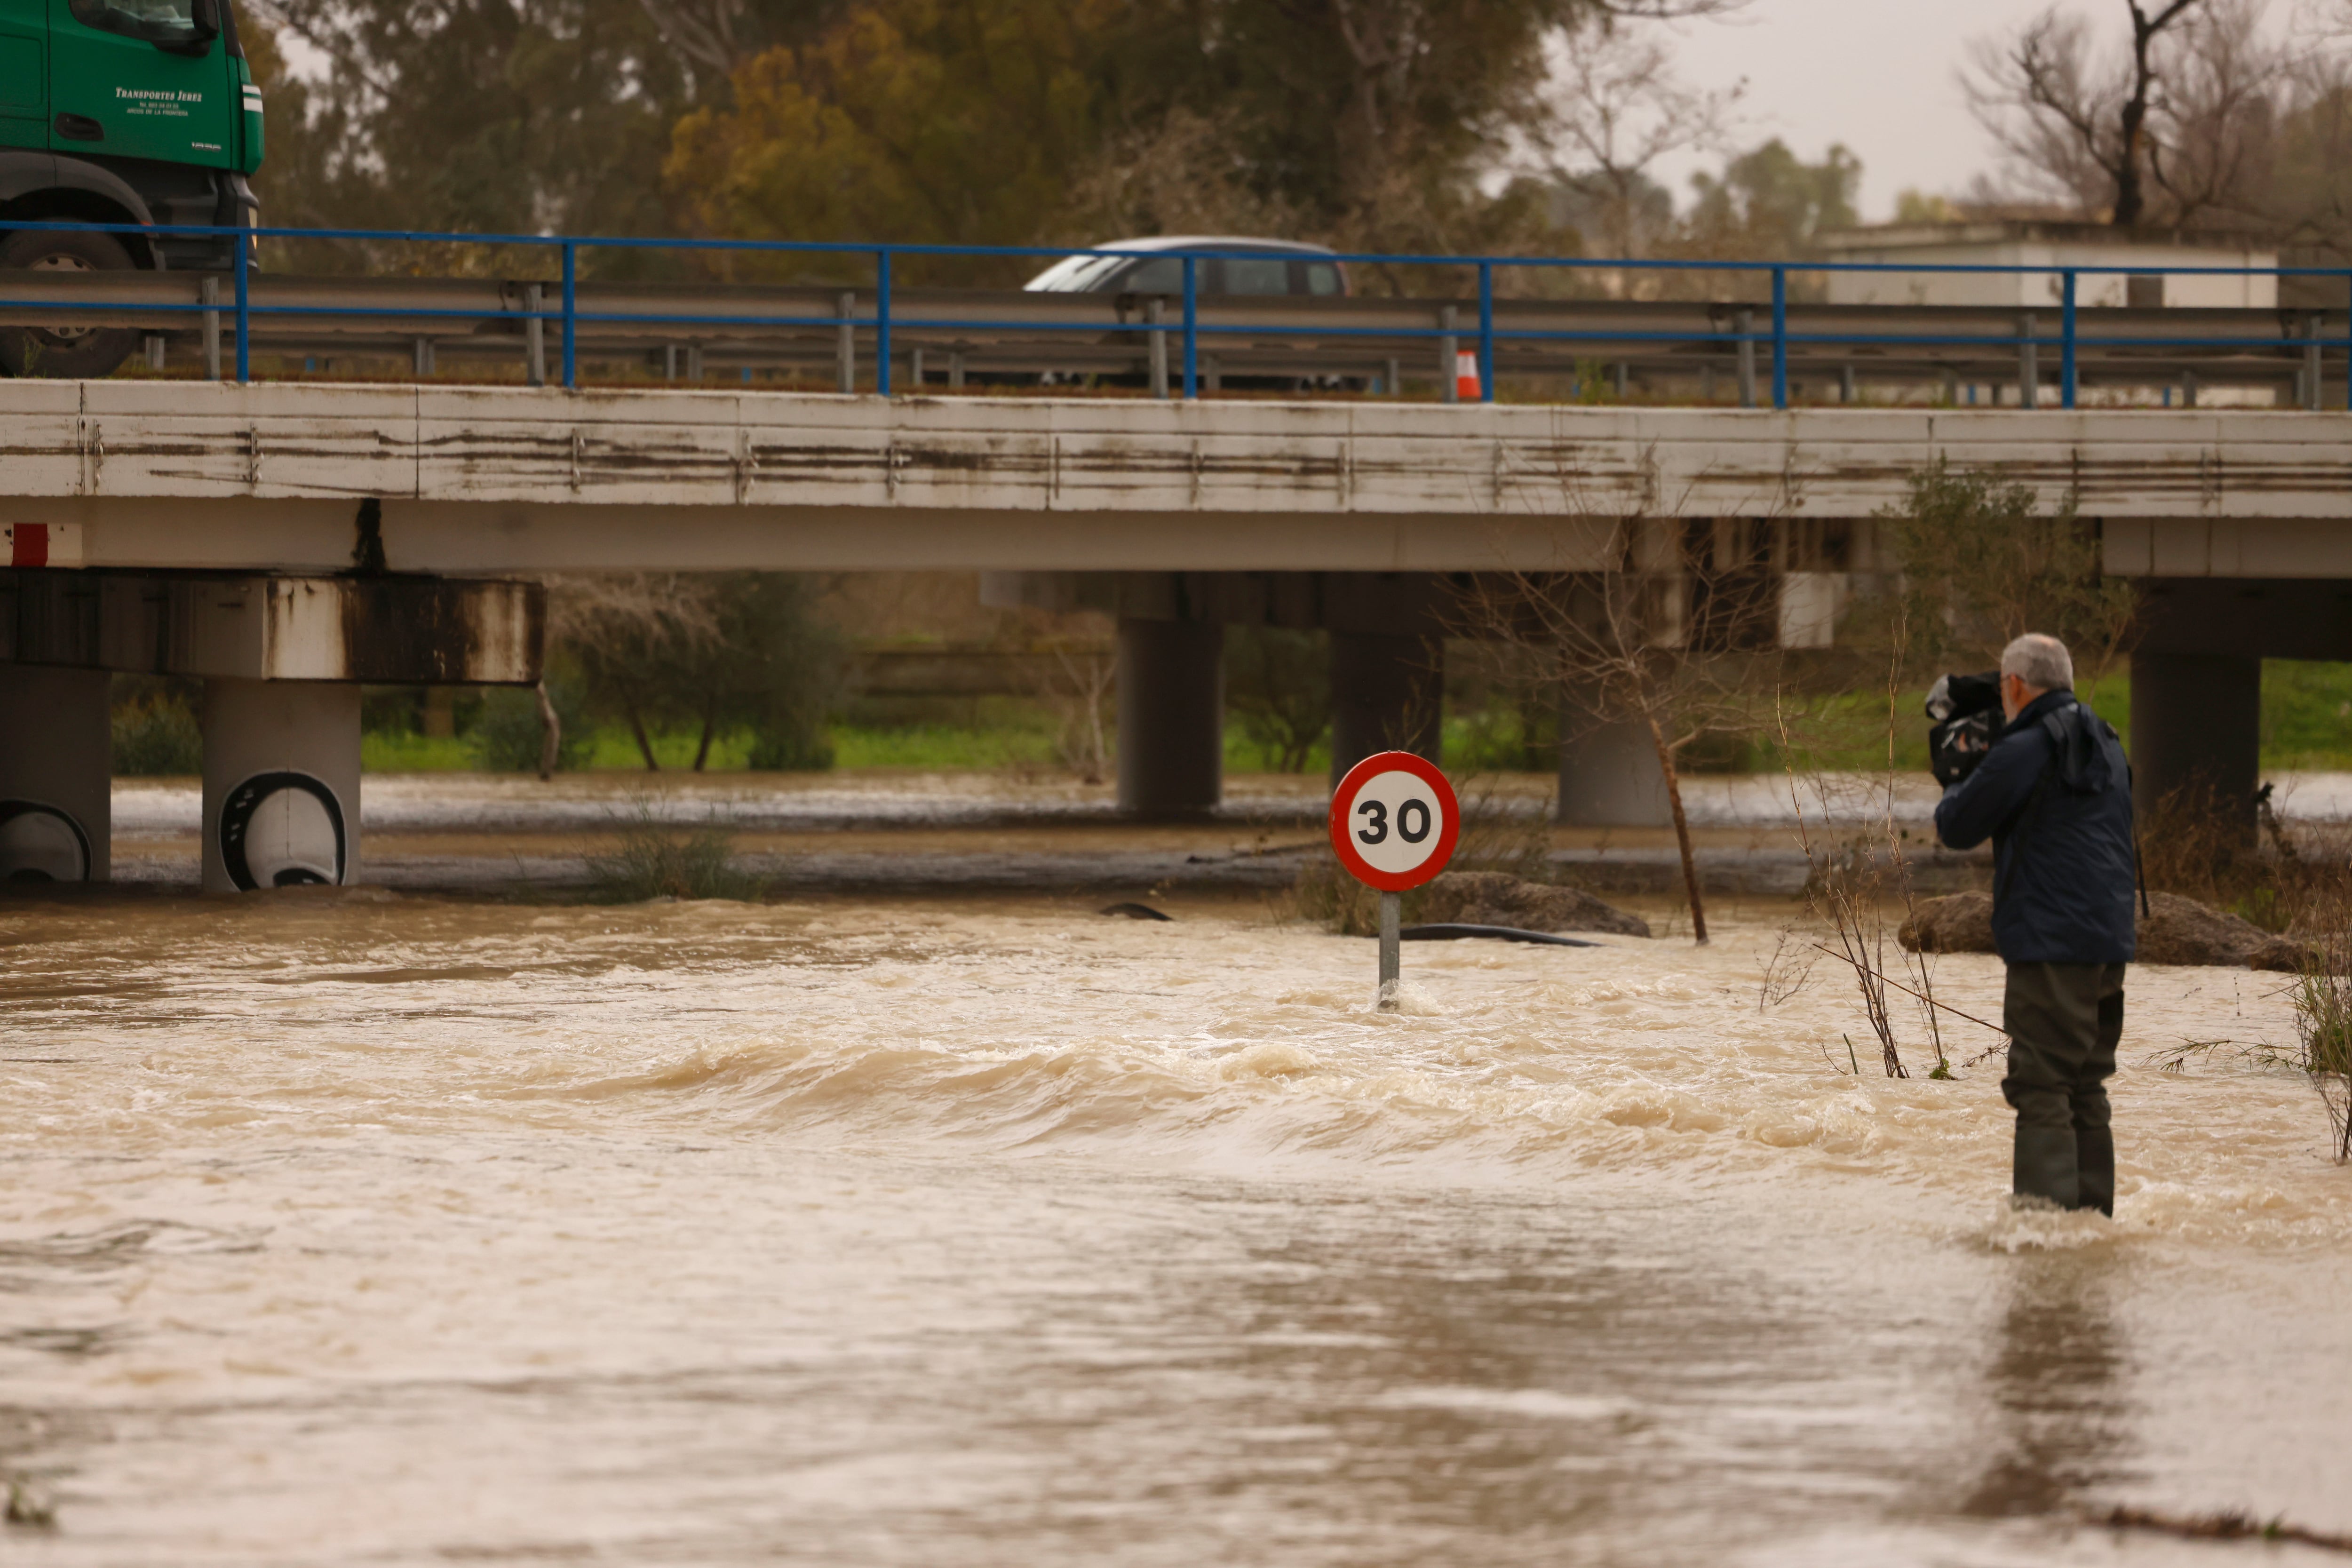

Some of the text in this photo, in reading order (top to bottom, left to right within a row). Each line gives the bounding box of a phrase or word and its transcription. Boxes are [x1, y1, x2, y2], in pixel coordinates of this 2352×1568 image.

[116, 87, 202, 102] TRANSPORTES JEREZ
[1358, 799, 1430, 844] 30
